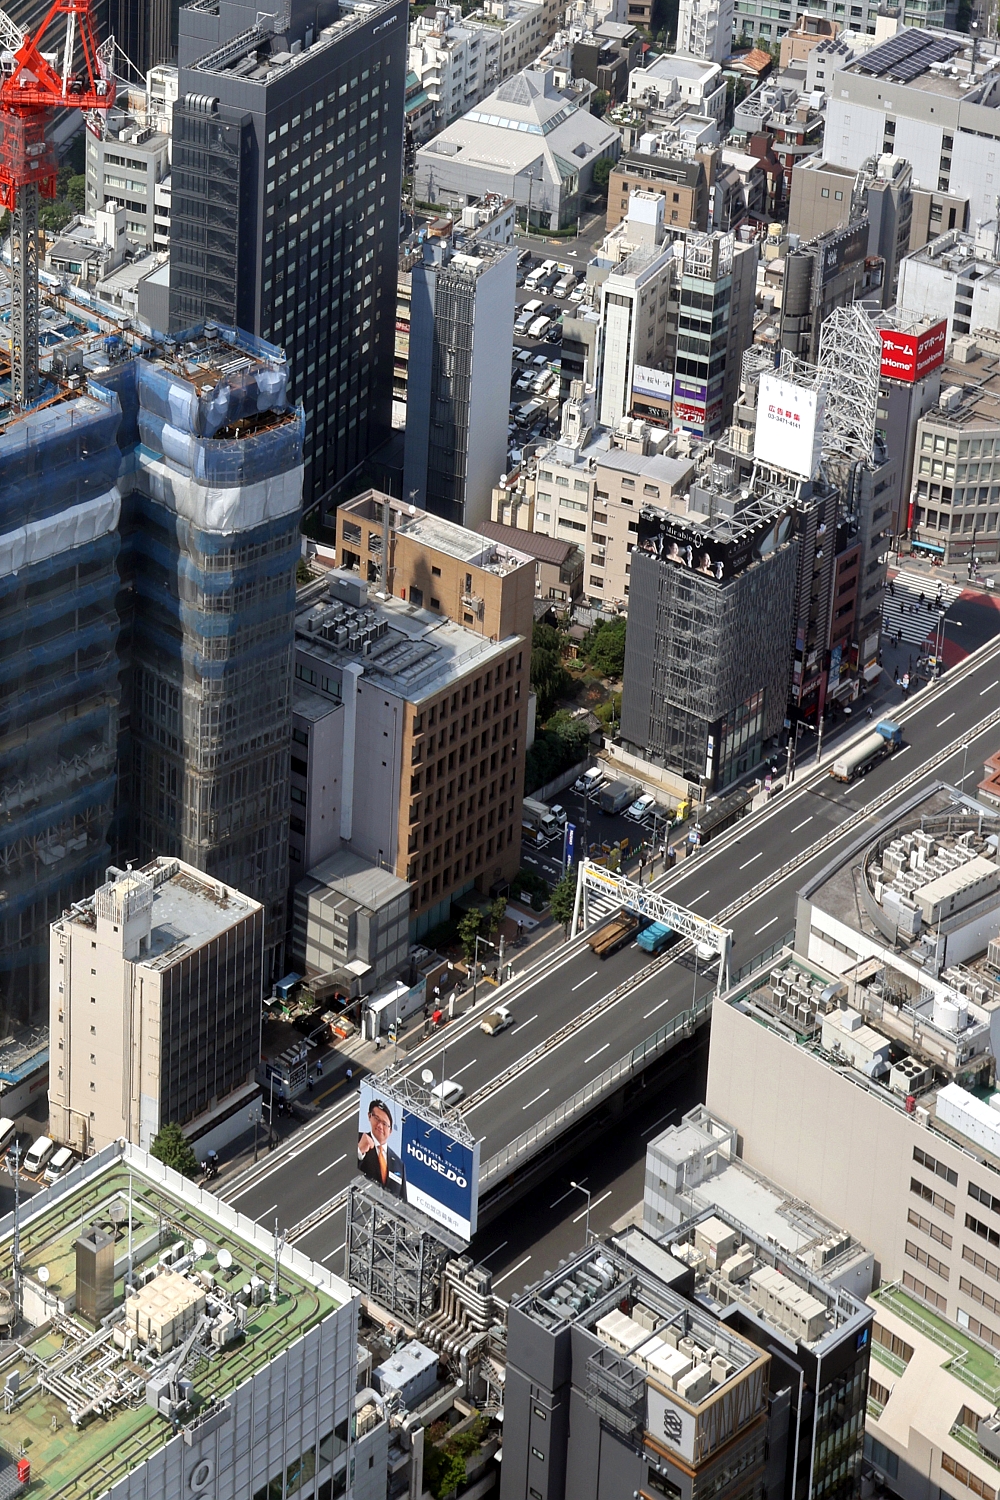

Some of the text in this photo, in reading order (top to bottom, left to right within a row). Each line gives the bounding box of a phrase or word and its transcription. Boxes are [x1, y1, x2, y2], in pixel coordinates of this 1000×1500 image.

[918, 331, 945, 354] タマホーム
[676, 410, 704, 424] アイフル
[767, 412, 801, 430] 03-3471-4141
